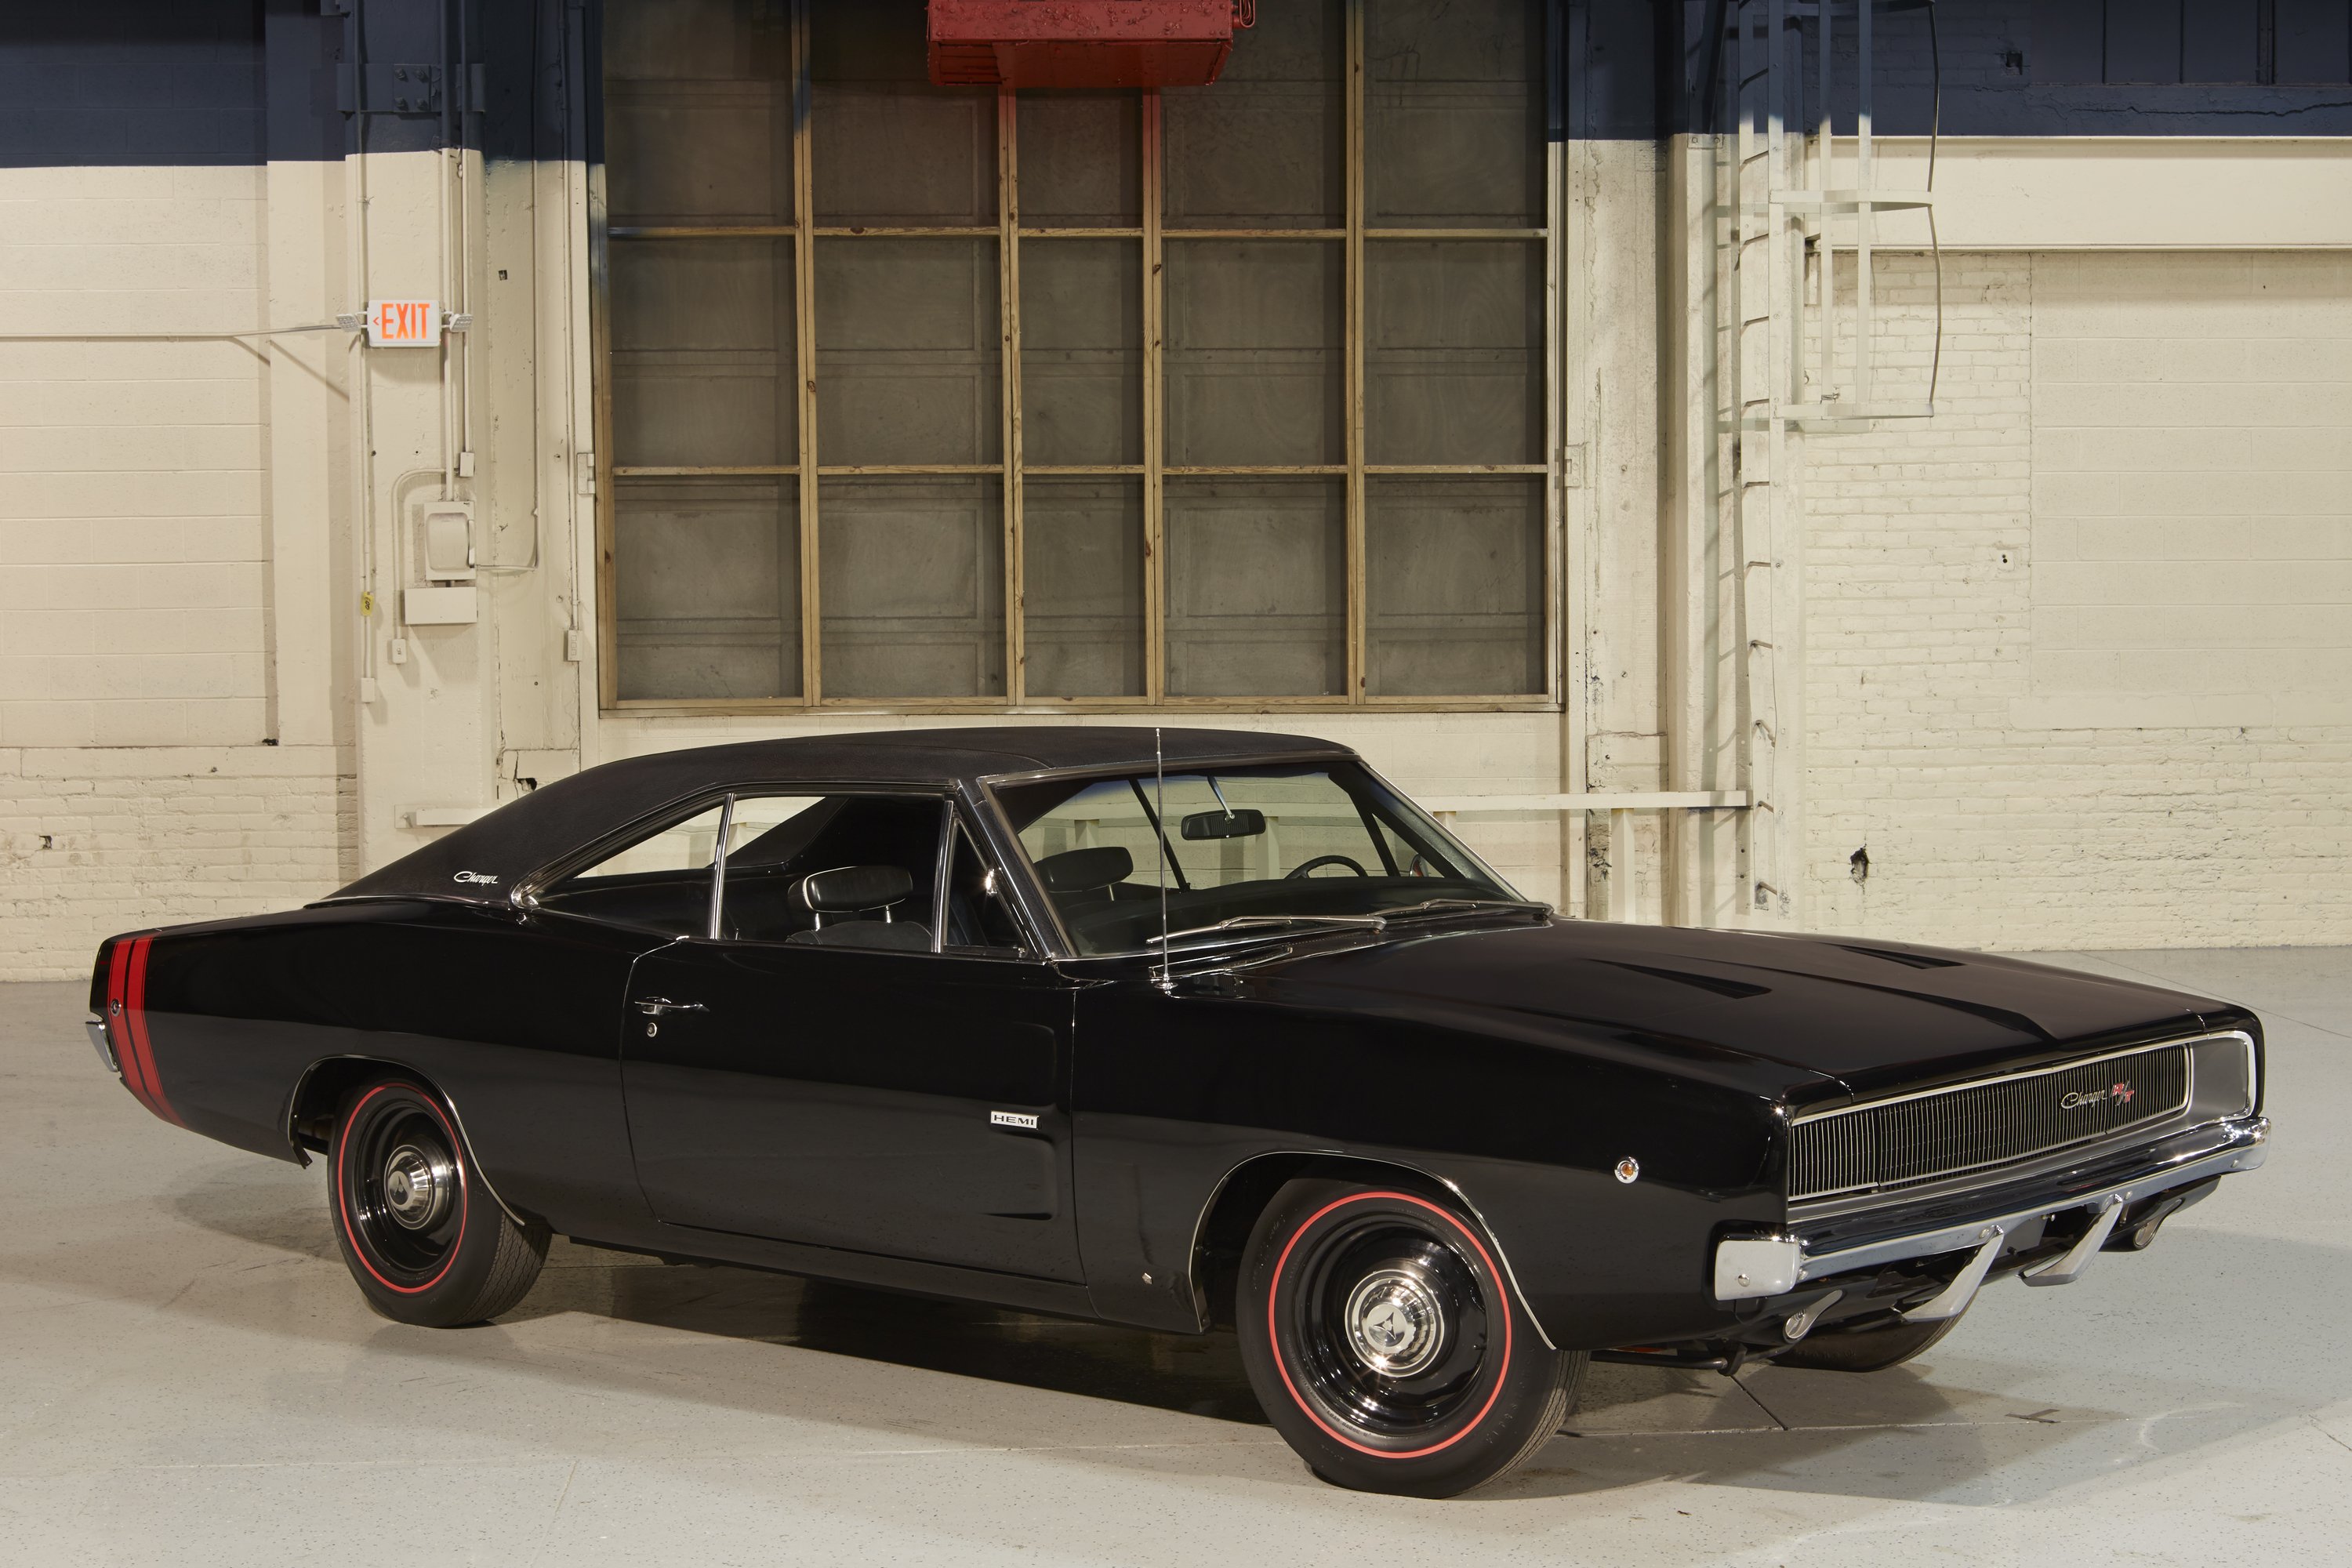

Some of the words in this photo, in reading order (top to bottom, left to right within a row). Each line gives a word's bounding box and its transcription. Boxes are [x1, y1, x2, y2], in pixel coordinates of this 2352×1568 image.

[381, 303, 430, 339] EXIT
[454, 871, 498, 886] Charger
[2060, 1090, 2107, 1109] Charger
[2112, 1080, 2135, 1106] R/T
[994, 1115, 1033, 1125] HEMI
